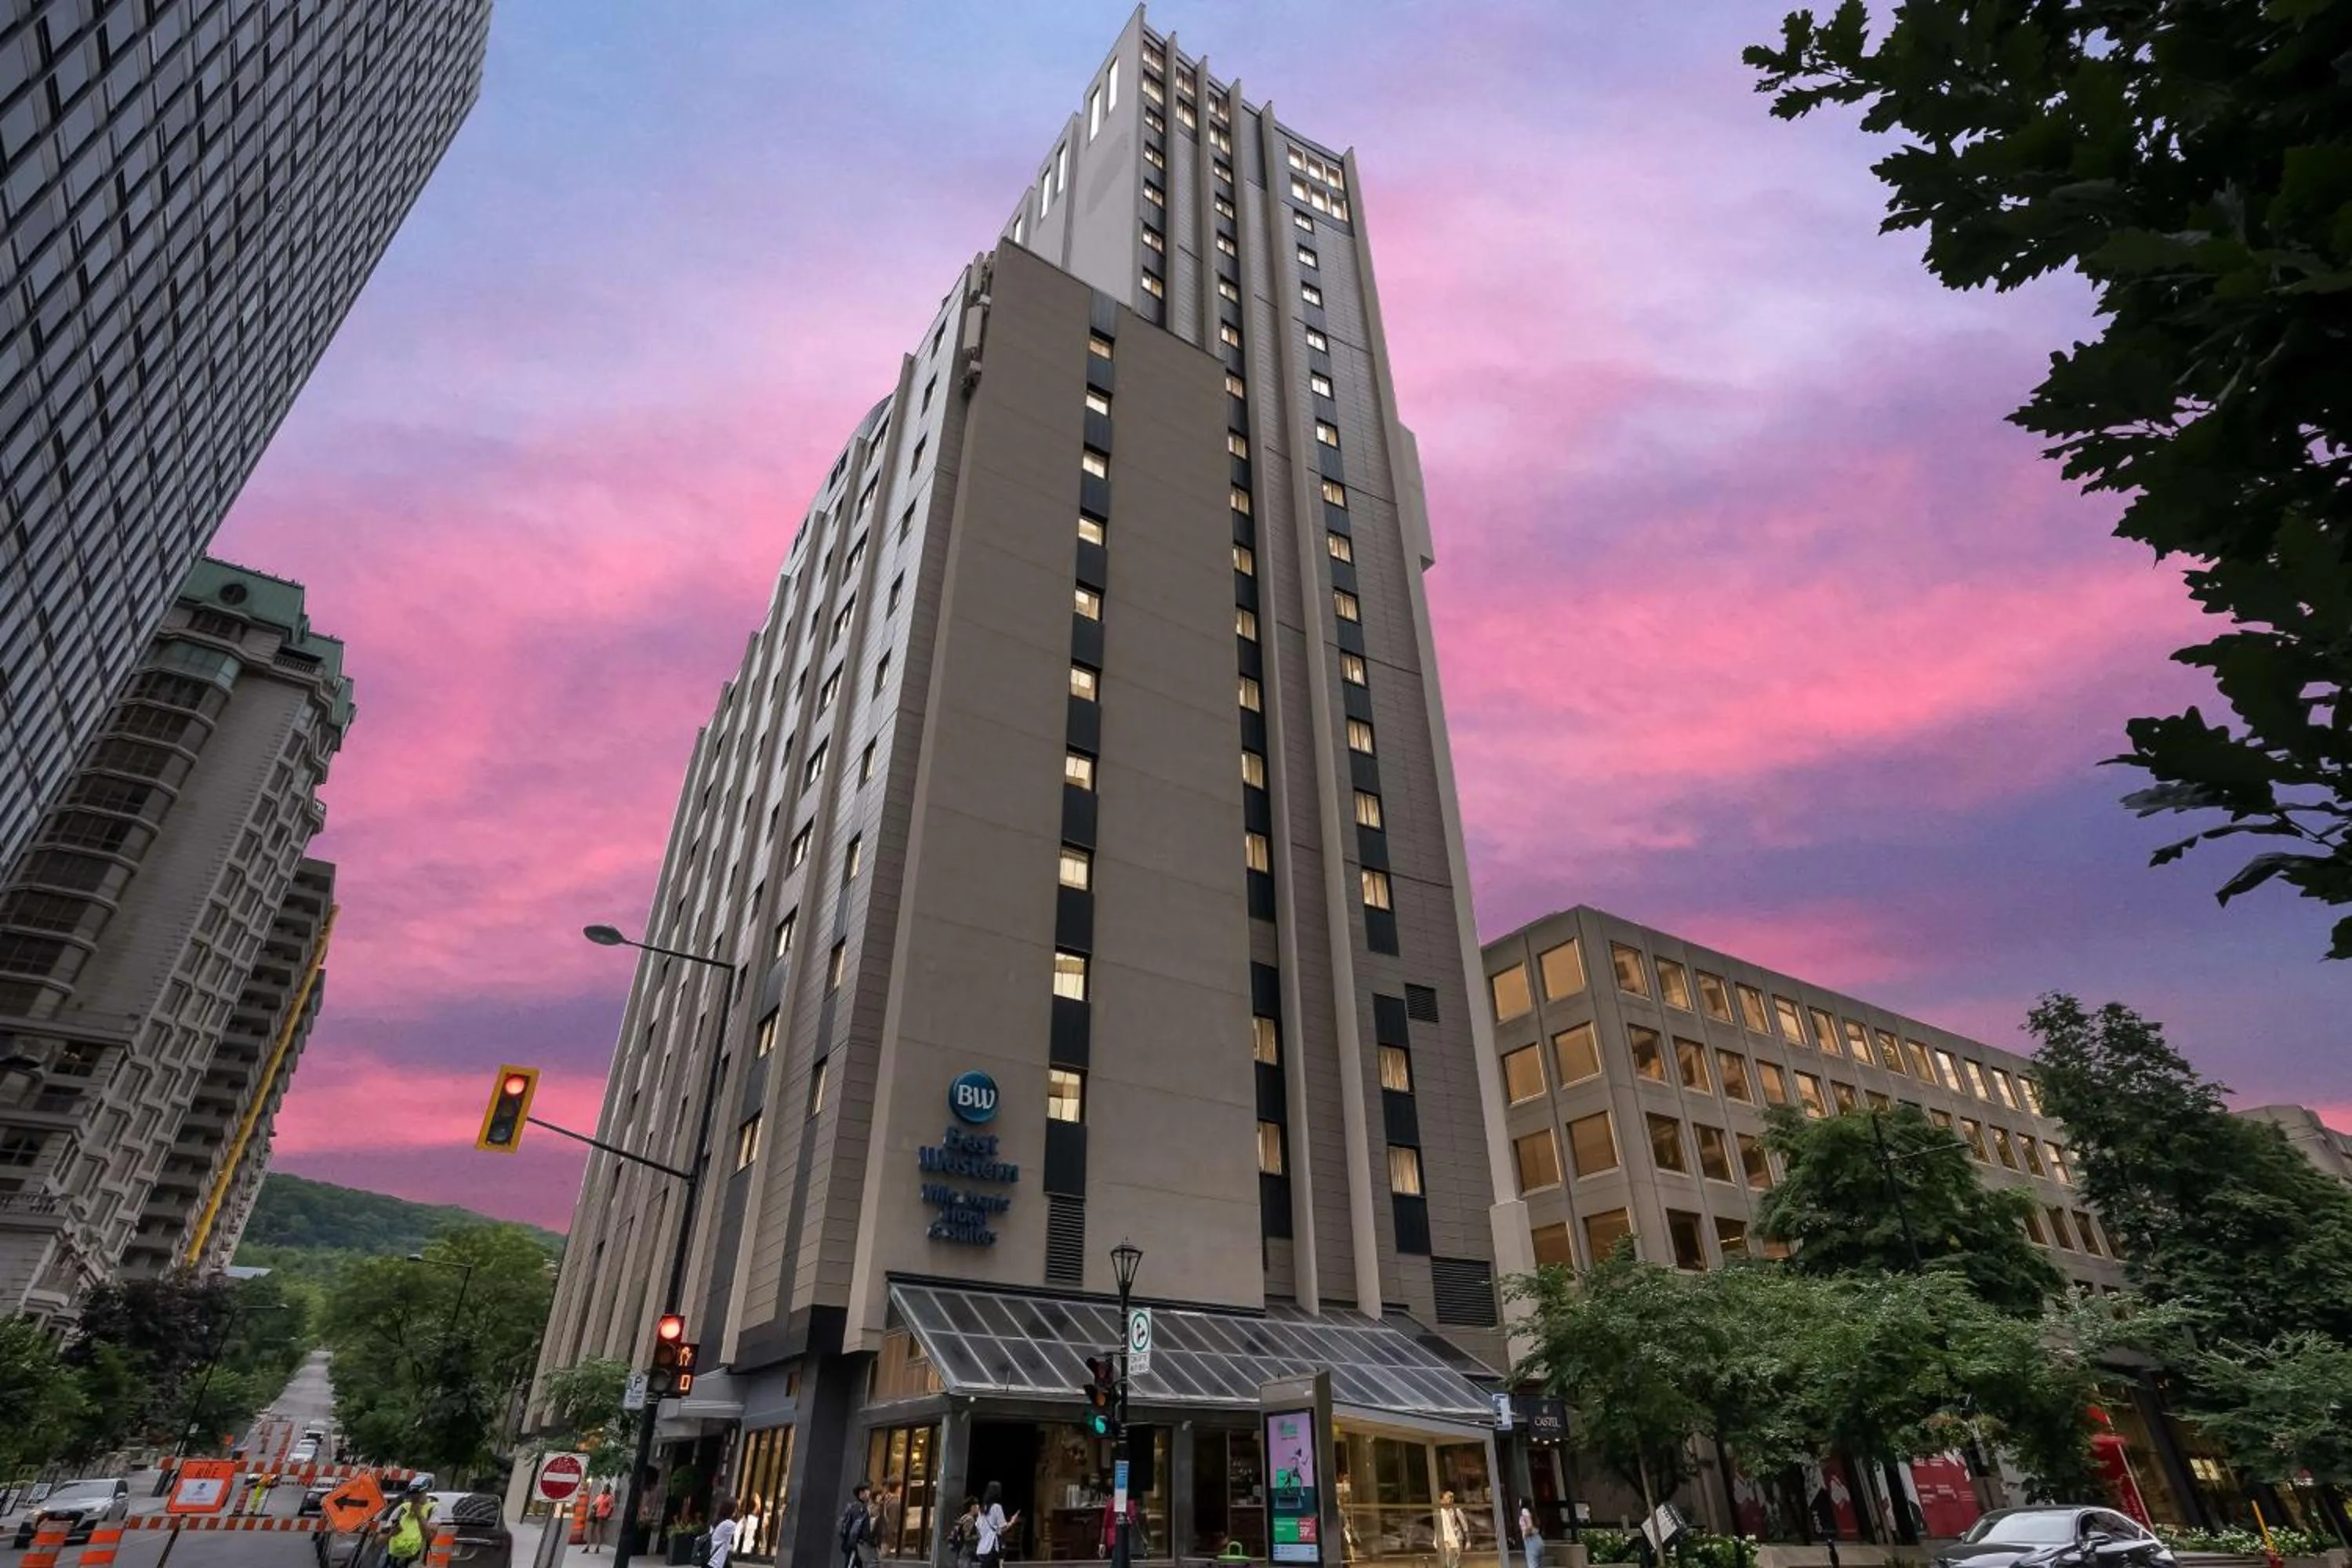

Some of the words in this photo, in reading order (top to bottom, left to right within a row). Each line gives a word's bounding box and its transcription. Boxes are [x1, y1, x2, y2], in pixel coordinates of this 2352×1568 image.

[958, 1084, 995, 1109] BW
[943, 1126, 1000, 1156] Best
[918, 1145, 1019, 1183] Western
